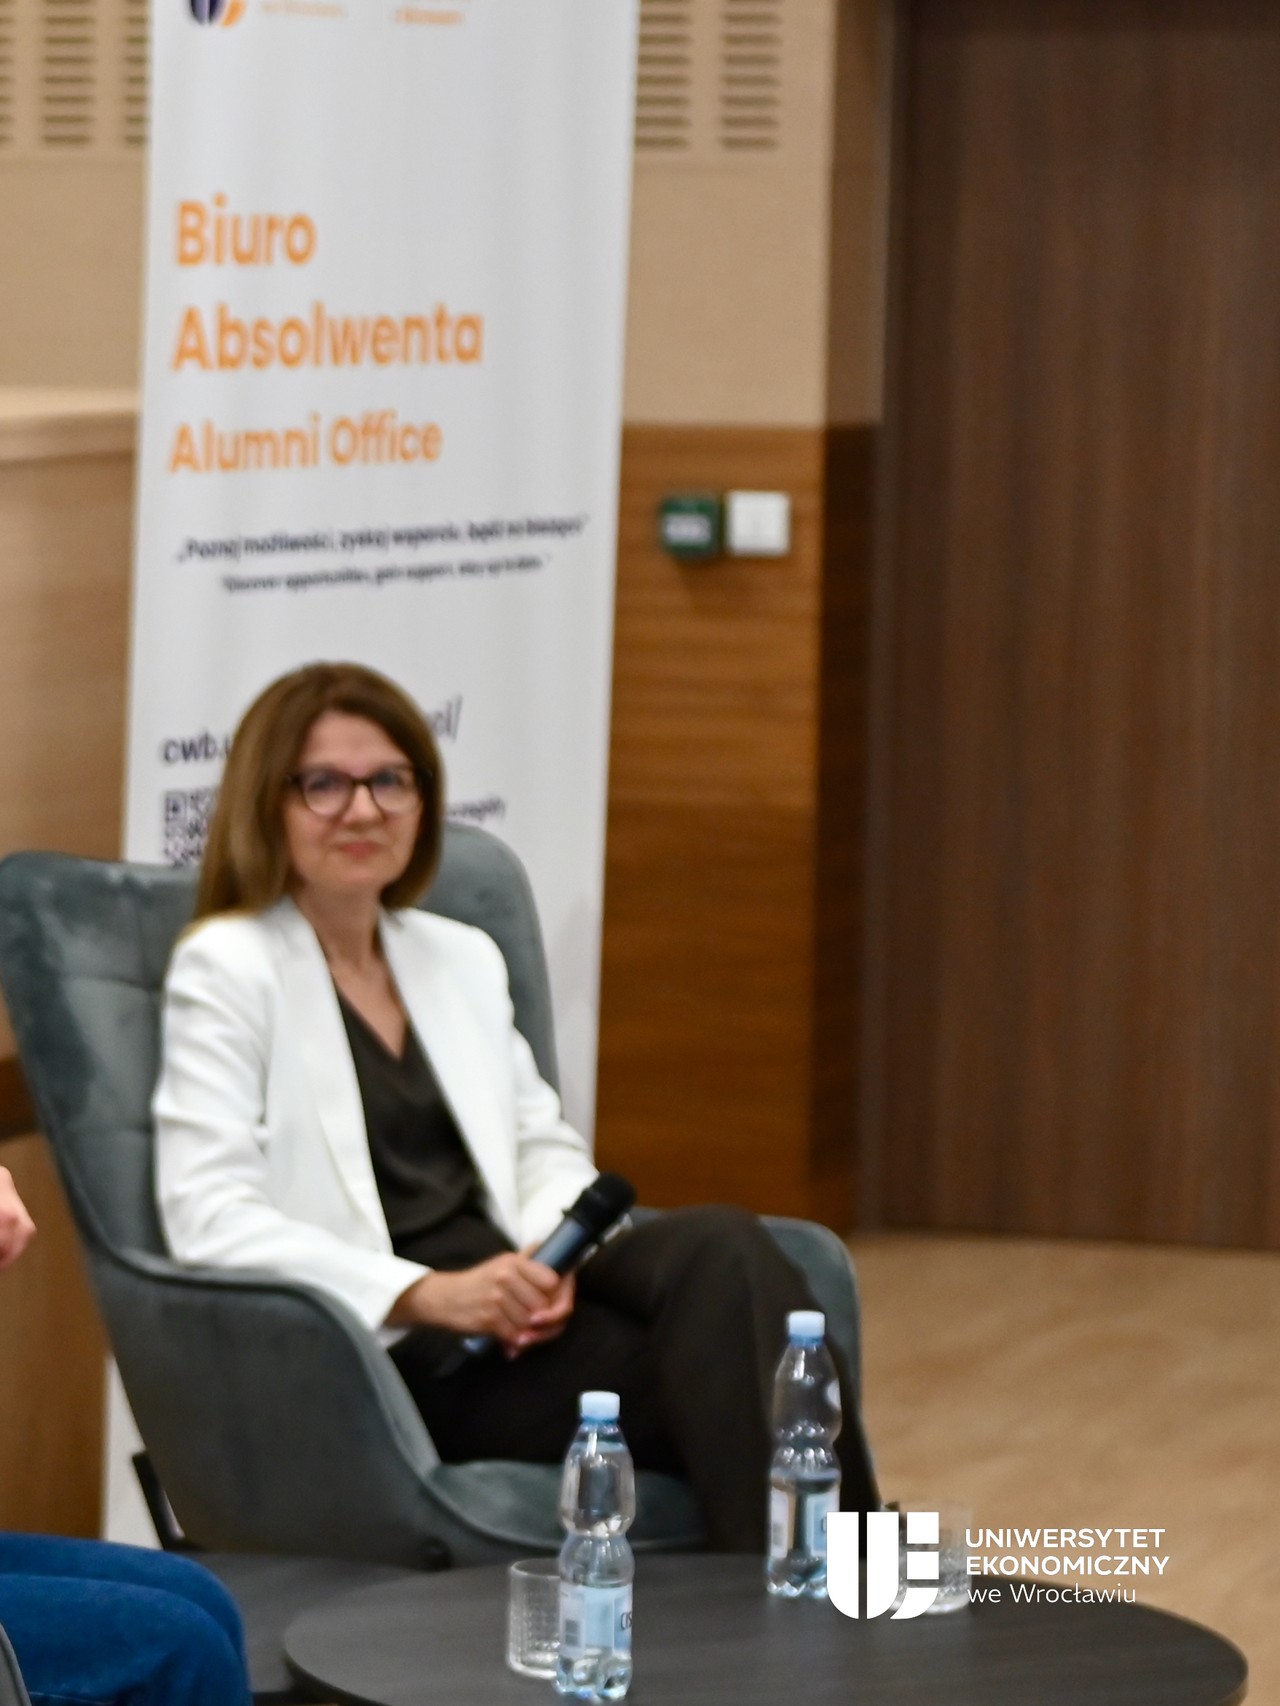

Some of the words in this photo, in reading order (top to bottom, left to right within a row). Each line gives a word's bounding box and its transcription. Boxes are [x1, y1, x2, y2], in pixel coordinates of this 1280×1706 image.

[176, 195, 317, 266] Biuro
[172, 303, 484, 371] Absolwenta
[170, 415, 320, 473] Alumni
[329, 411, 443, 467] Office
